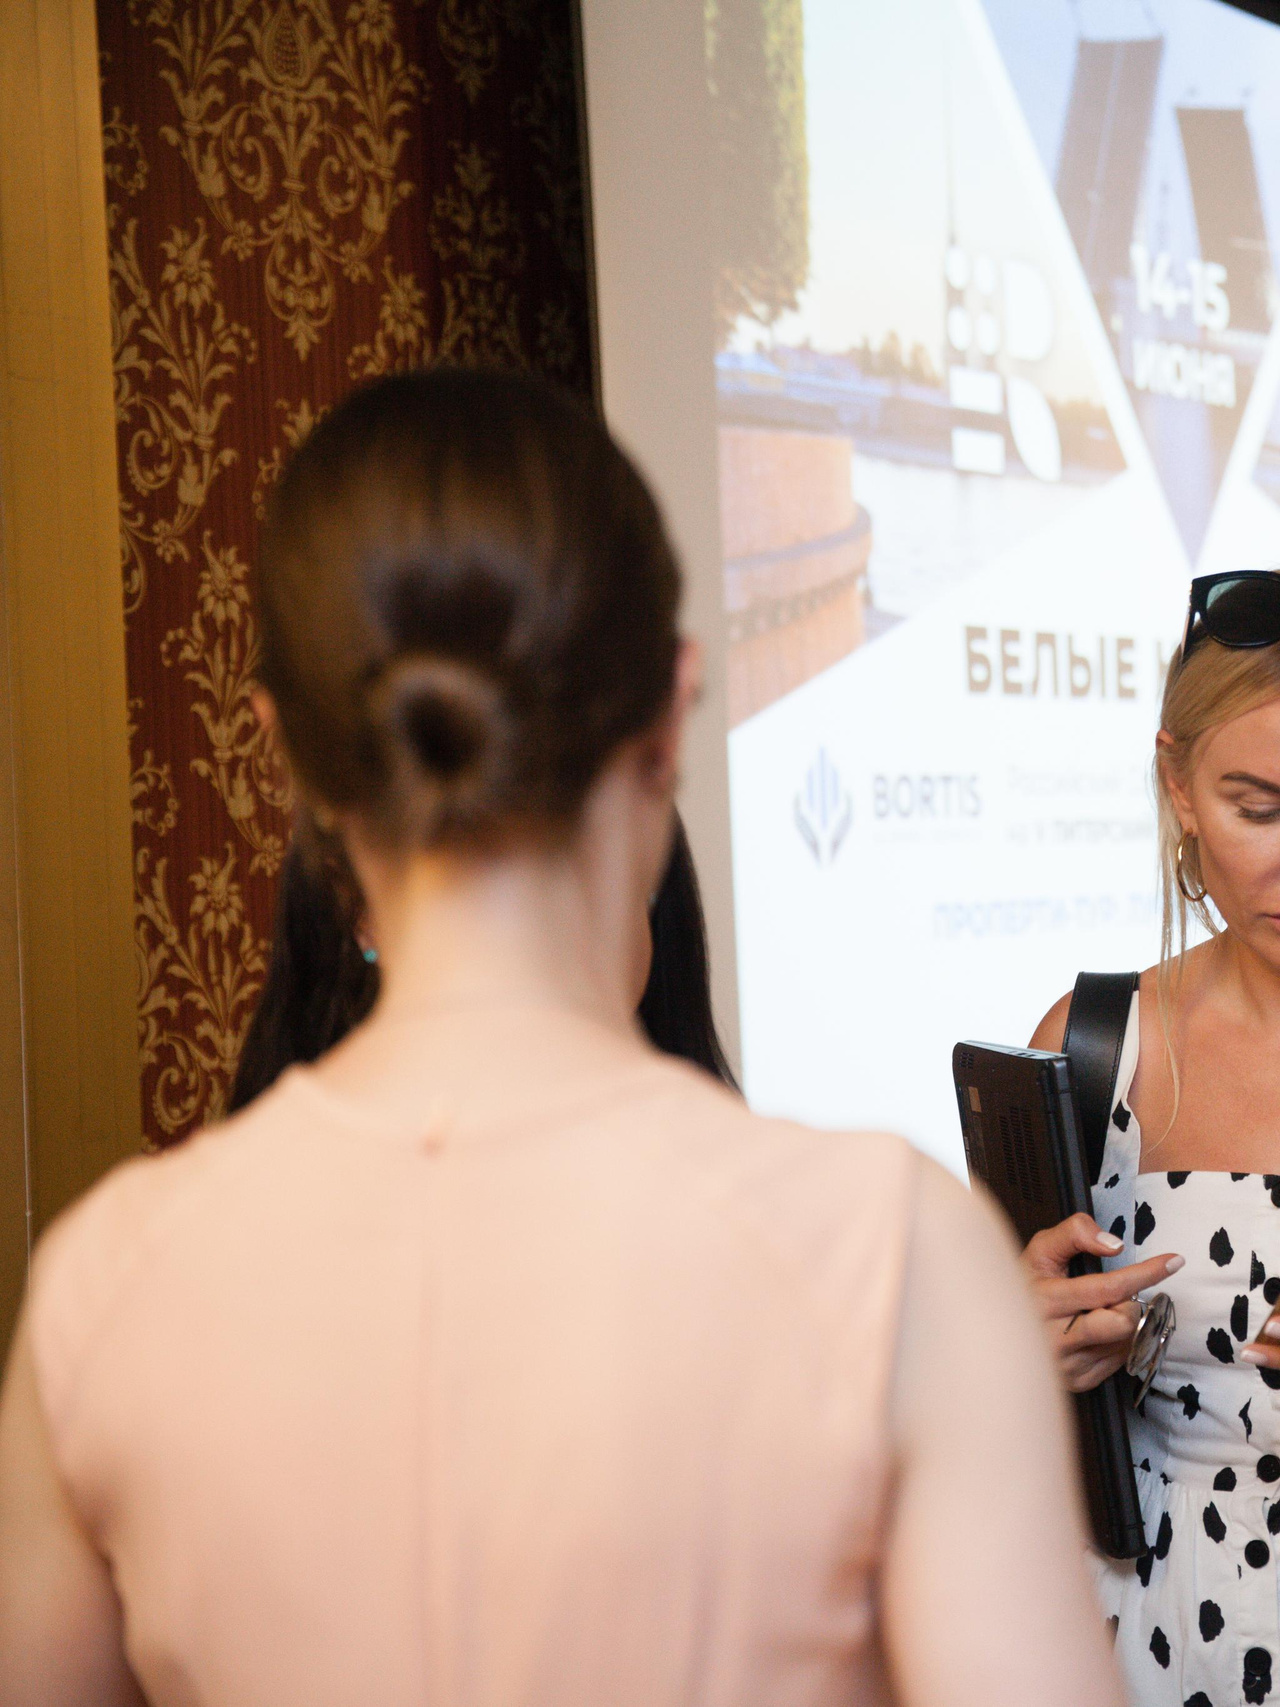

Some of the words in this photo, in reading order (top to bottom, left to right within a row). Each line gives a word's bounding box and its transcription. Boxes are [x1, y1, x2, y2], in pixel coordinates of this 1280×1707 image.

[1129, 243, 1230, 332] 14-15
[965, 625, 1136, 699] БЕЛЫЕ
[873, 773, 981, 820] BORTIS
